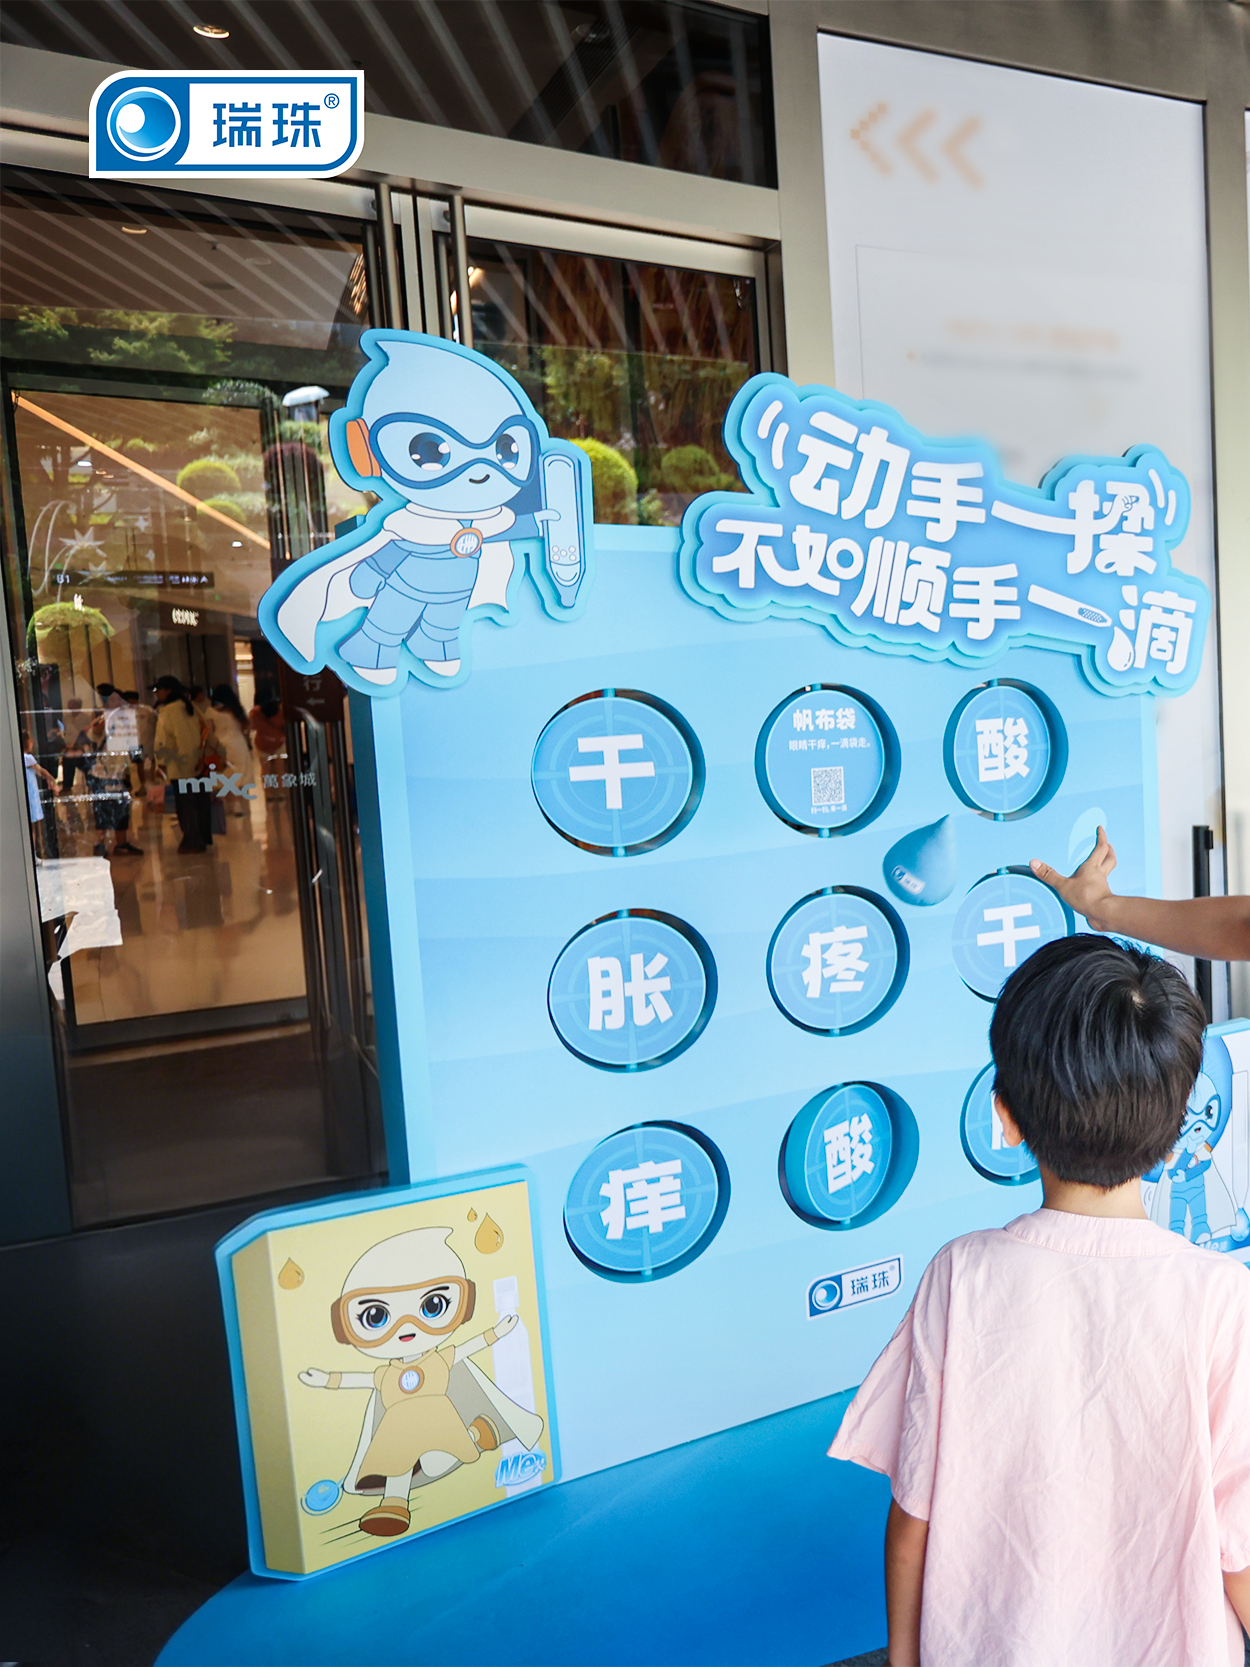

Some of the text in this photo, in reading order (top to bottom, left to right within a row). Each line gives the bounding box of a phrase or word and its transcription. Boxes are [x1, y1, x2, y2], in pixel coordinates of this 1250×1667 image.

[788, 411, 1157, 577] 动手一揉
[712, 518, 1198, 675] 不如顺手一滴
[792, 707, 857, 732] 帆布袋
[975, 716, 1031, 783] 酸
[262, 771, 317, 789] 萬象城
[569, 733, 656, 810] 干
[800, 925, 870, 999] 疼
[976, 902, 1041, 968] 干
[587, 951, 674, 1031] 胀
[823, 1112, 876, 1195] 酸
[599, 1158, 687, 1240] 痒
